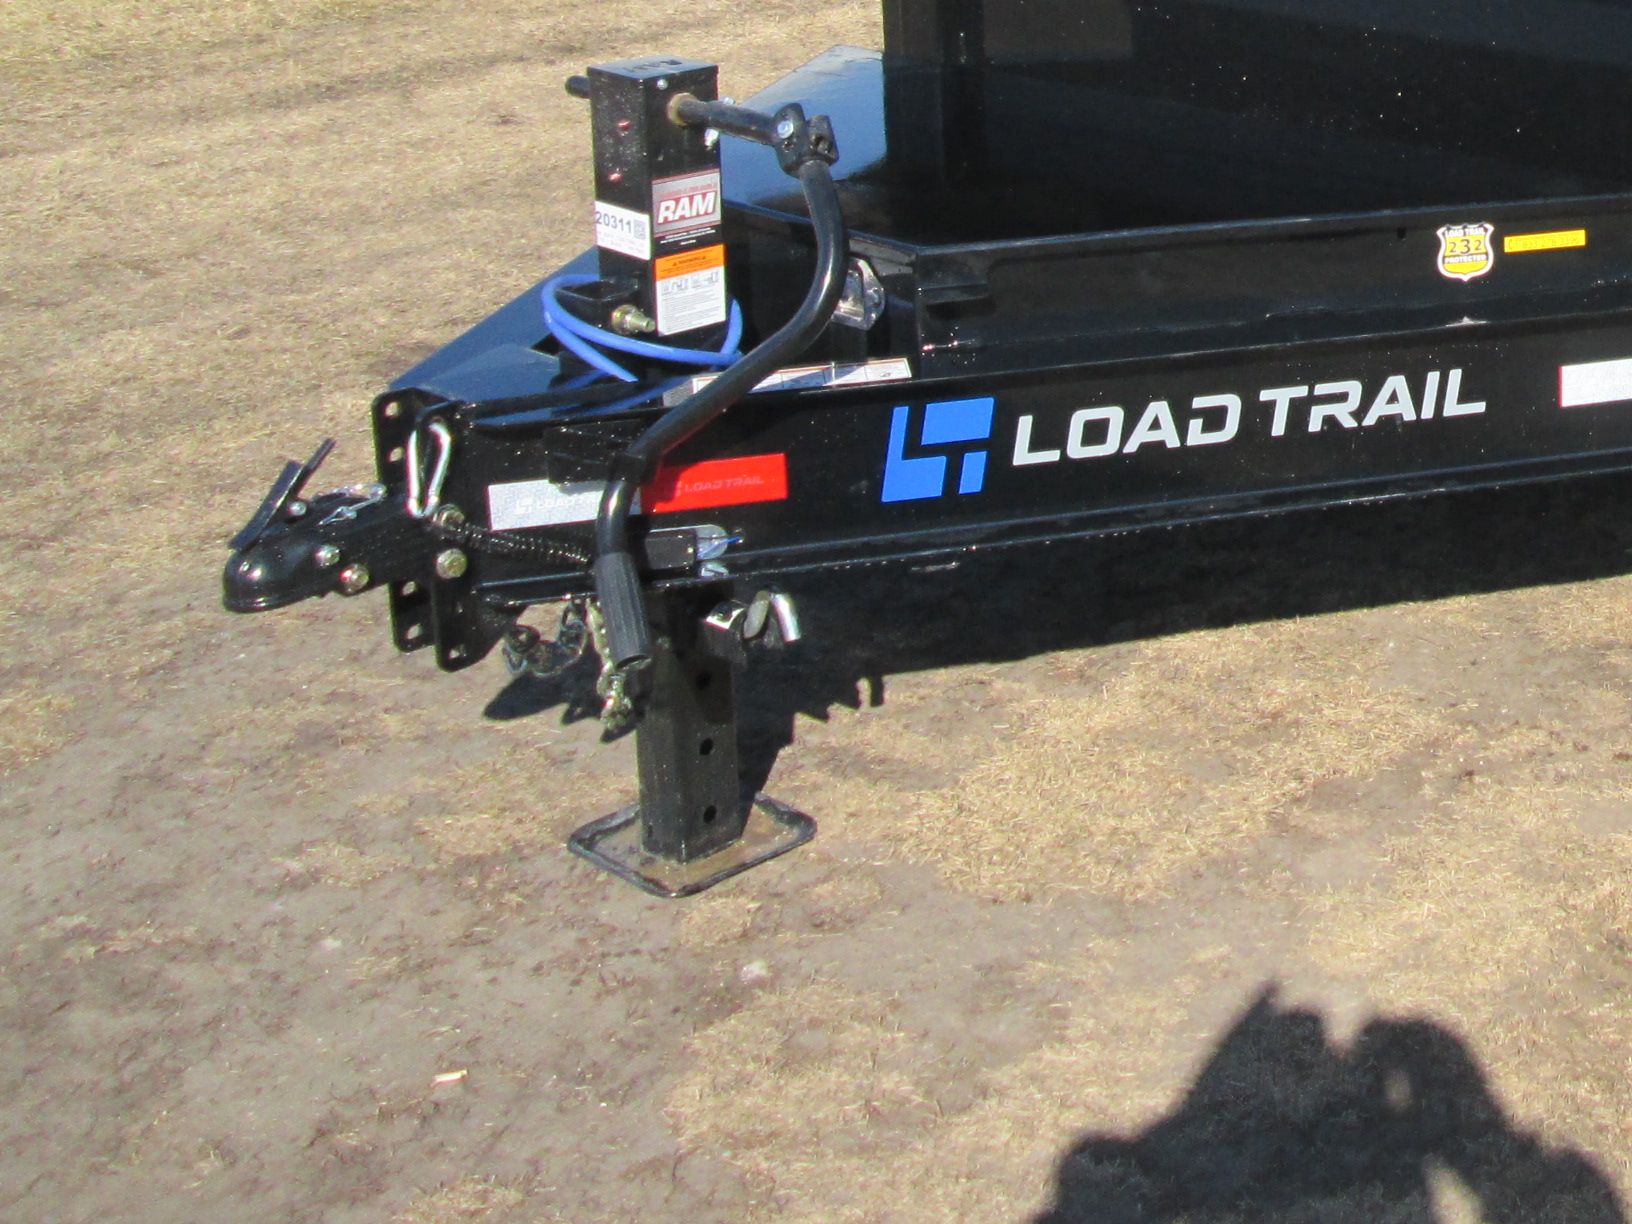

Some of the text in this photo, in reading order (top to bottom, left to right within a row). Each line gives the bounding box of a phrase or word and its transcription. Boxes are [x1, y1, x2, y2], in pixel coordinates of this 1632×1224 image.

[657, 191, 718, 225] RAM
[1445, 227, 1485, 238] LOAD TRAIL
[1445, 254, 1487, 264] PROTECTED
[1012, 368, 1487, 466] LOAD TRAIL
[684, 475, 765, 493] LOAD TRAIL
